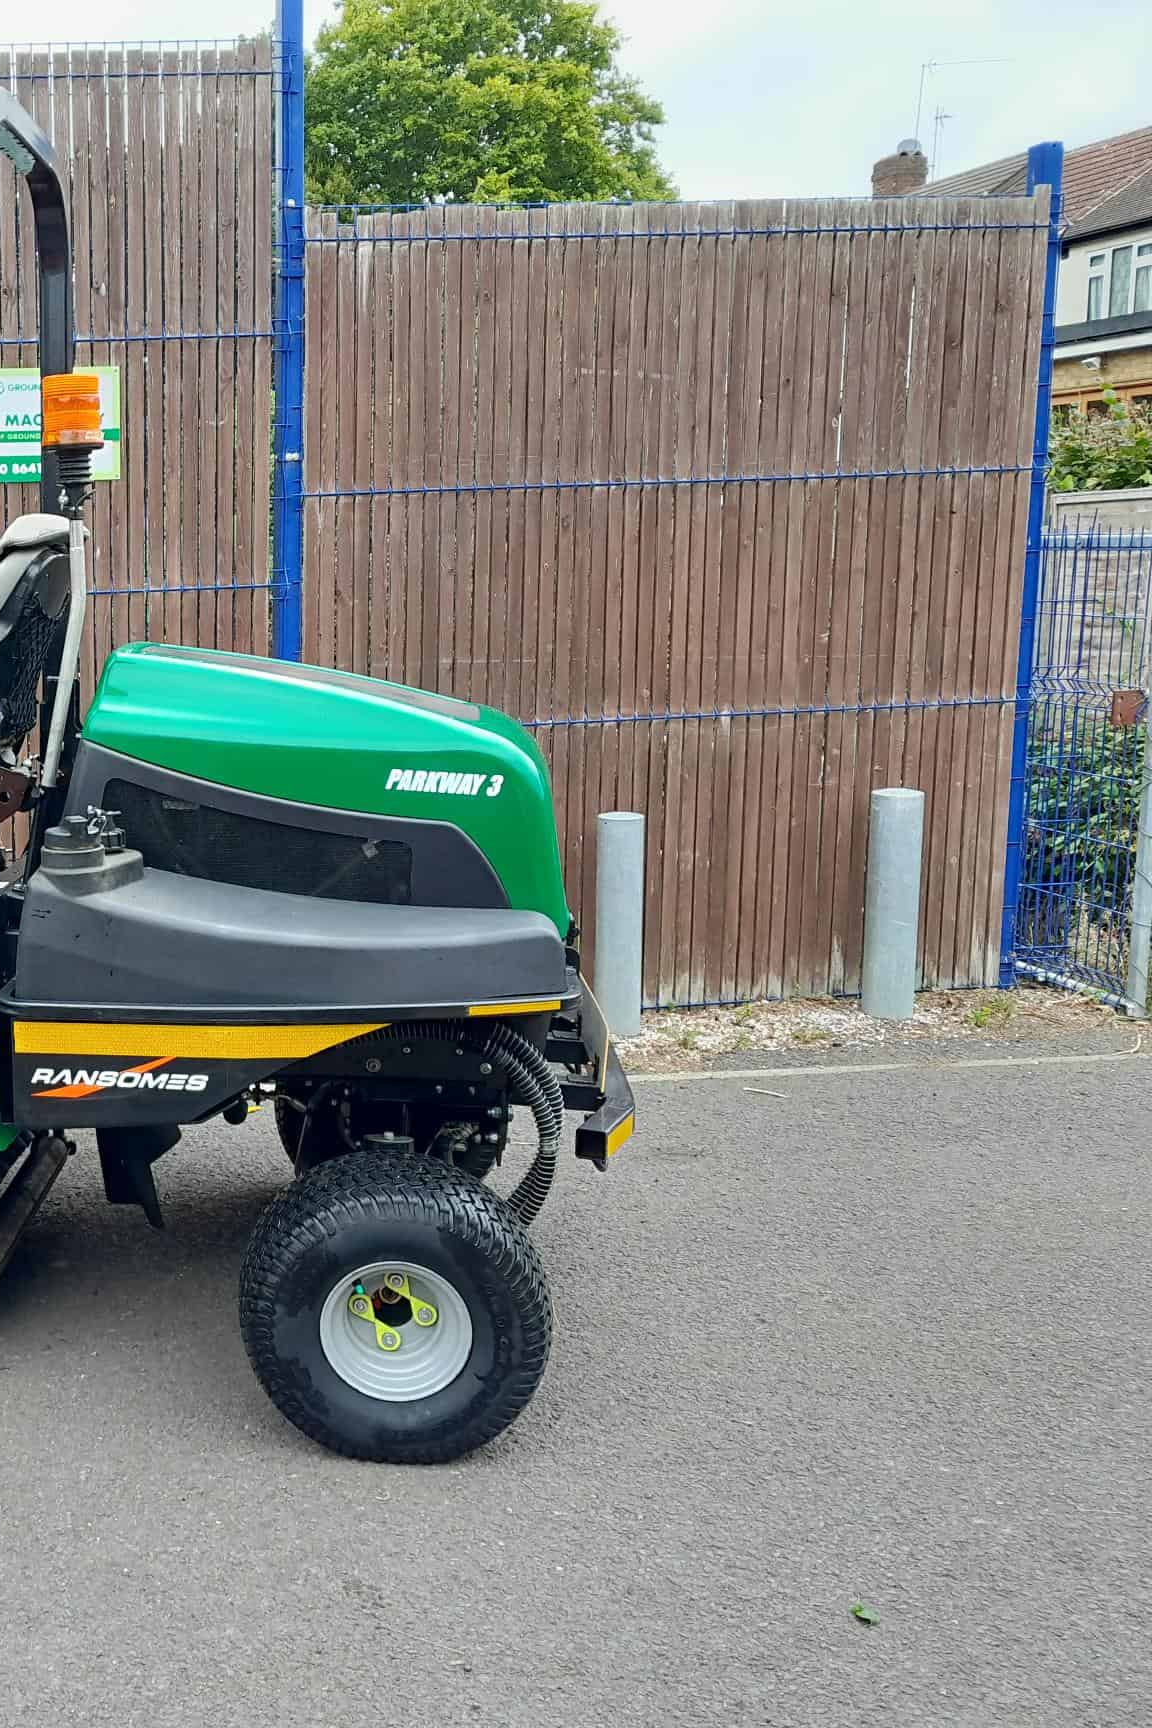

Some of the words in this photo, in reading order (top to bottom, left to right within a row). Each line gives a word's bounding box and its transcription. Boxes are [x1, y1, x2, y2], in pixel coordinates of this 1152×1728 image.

[385, 768, 487, 796] PARKWAY
[486, 774, 504, 797] 3
[31, 1068, 209, 1091] RANSOMES
